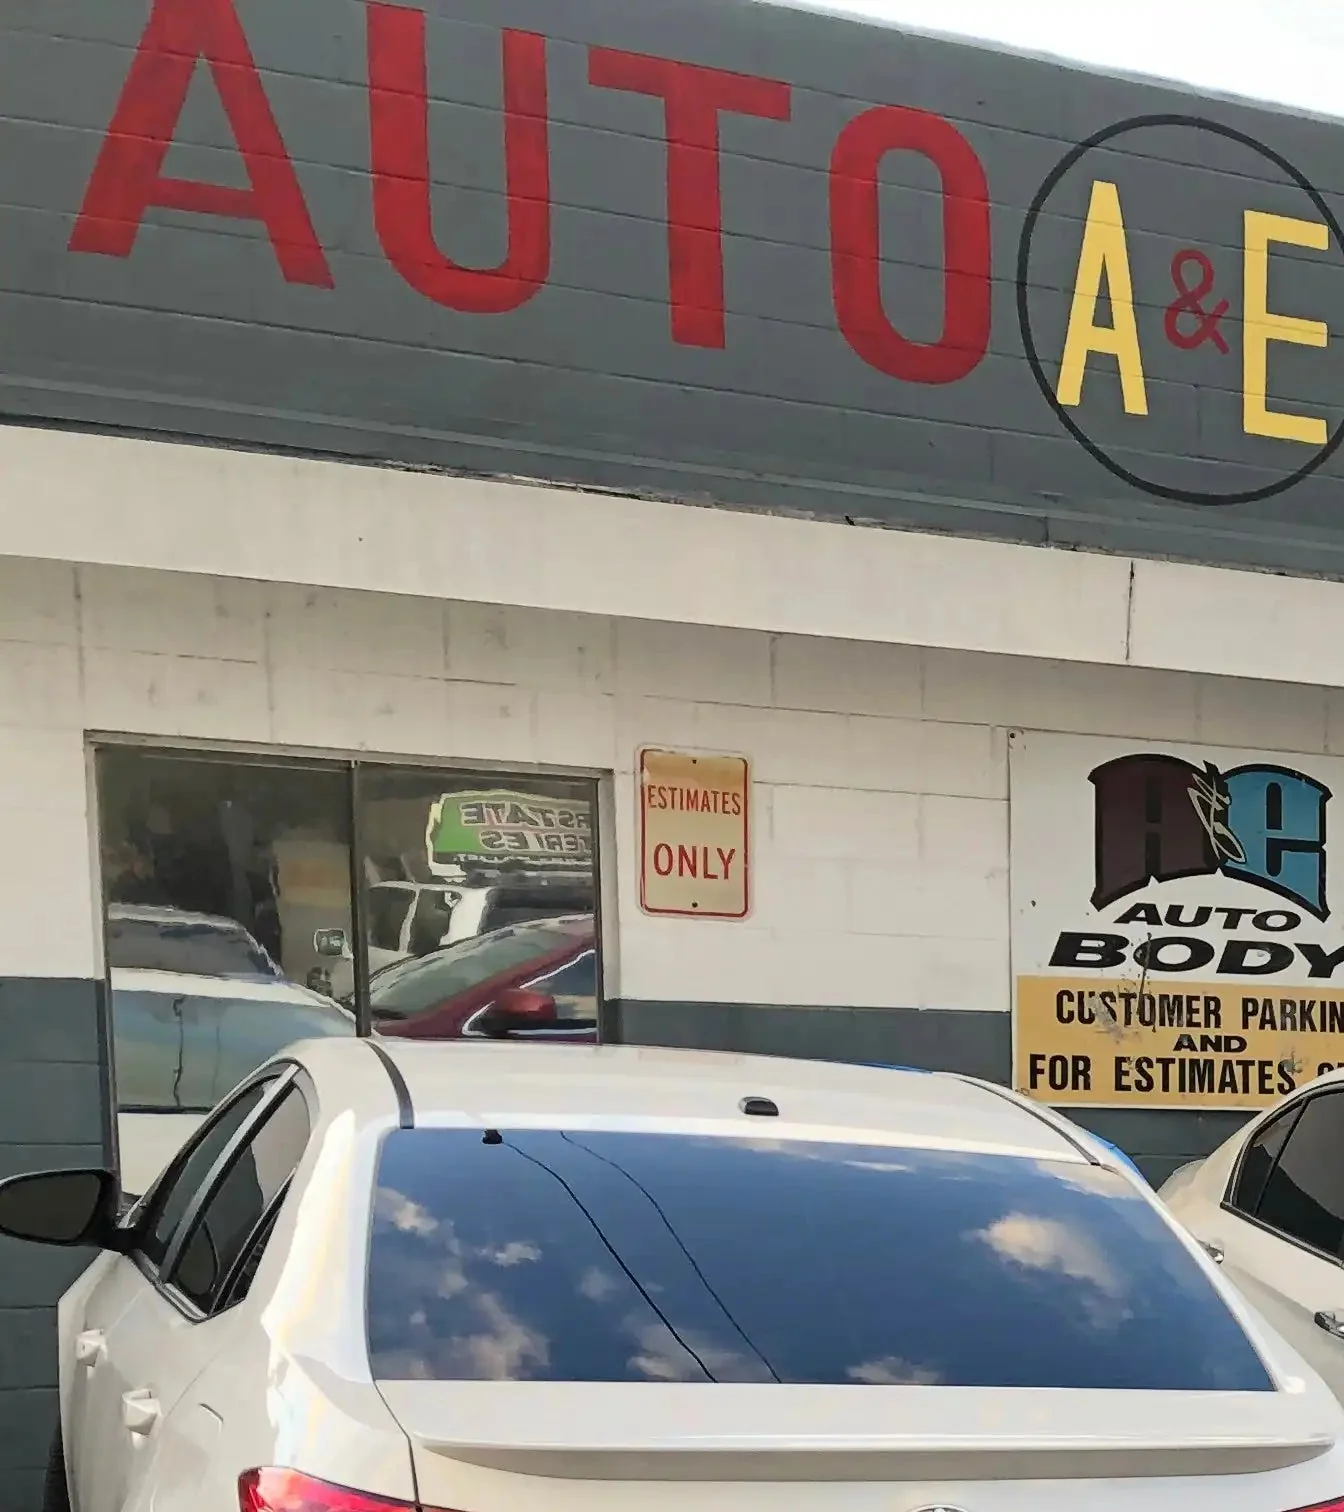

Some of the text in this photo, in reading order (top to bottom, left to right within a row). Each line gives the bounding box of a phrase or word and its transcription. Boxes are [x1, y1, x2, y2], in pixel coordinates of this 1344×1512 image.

[67, 0, 993, 385] AUTO
[647, 785, 741, 816] ESTIMATES
[653, 843, 736, 880] ONLY
[1113, 902, 1301, 932] AUTO
[1056, 989, 1222, 1032] CUSTOMER
[1173, 1033, 1247, 1054] AND
[1029, 1053, 1091, 1092] FOR
[1114, 1056, 1297, 1096] ESTIMATES
